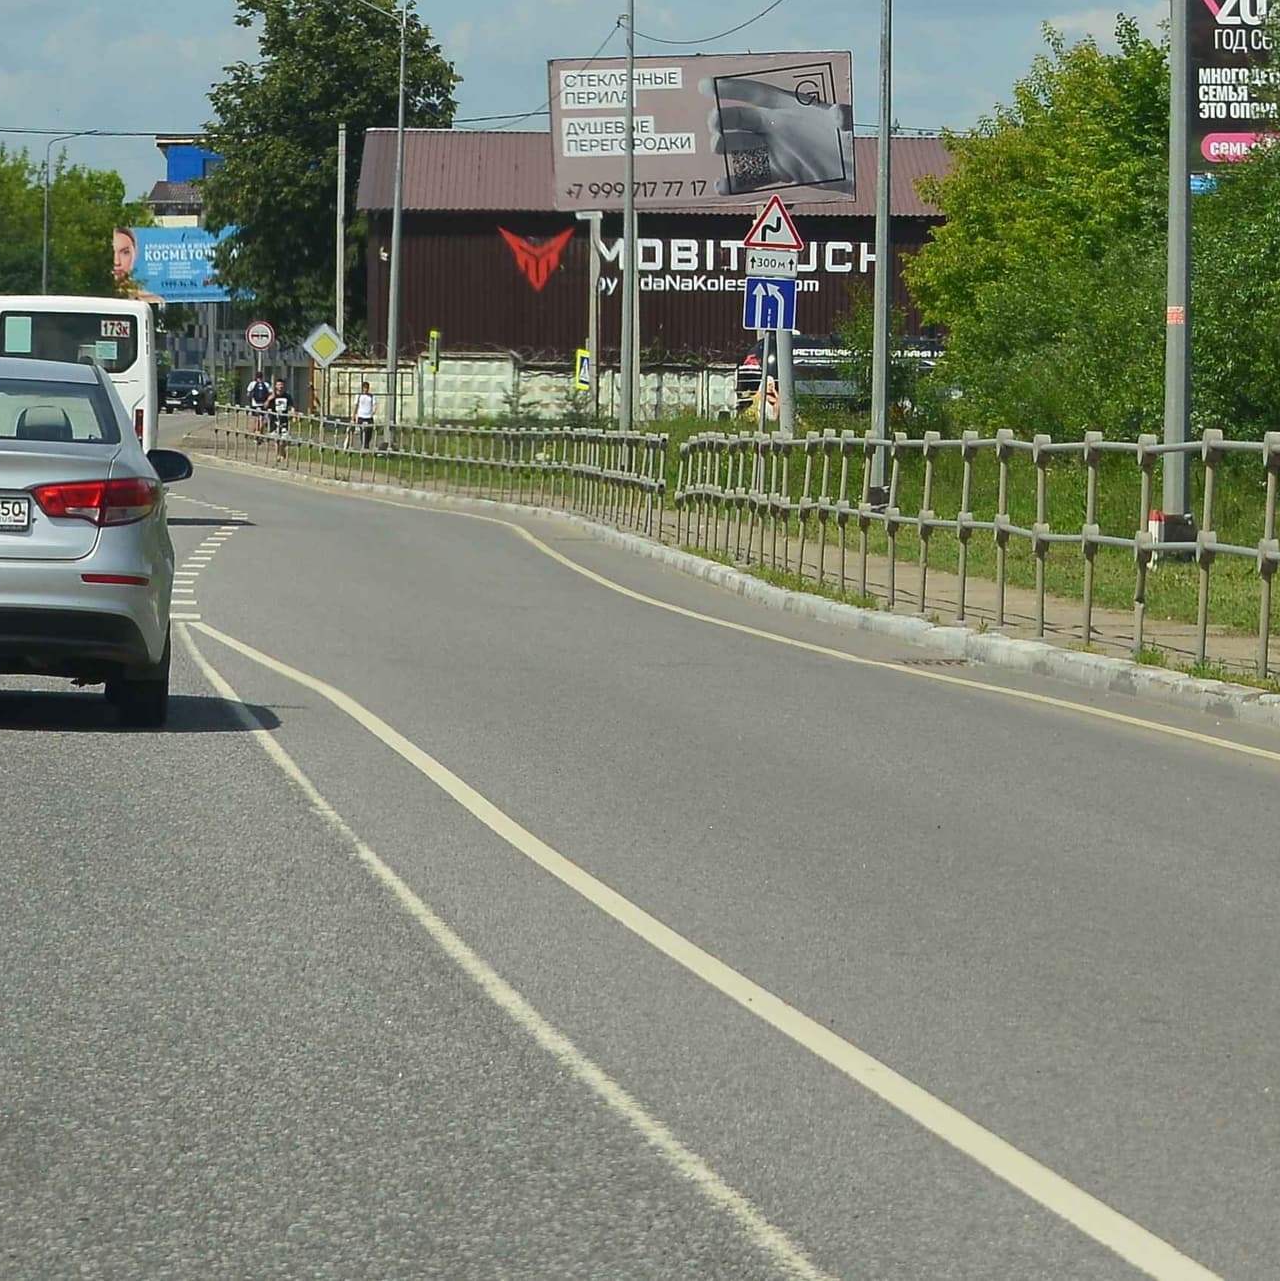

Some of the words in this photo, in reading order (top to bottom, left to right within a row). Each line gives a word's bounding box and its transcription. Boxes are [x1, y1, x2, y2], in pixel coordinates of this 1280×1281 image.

[1214, 29, 1248, 54] ГОД
[1199, 85, 1248, 101] СЕМЬЯ
[1199, 102, 1226, 118] ЭТО
[567, 137, 691, 151] ПЕРЕГОРОДКИ
[566, 183, 583, 199] +7
[588, 182, 625, 198] 999
[632, 182, 657, 198] 717
[662, 181, 683, 197] 77
[691, 181, 707, 196] 17
[599, 238, 876, 273] MOBITUCH
